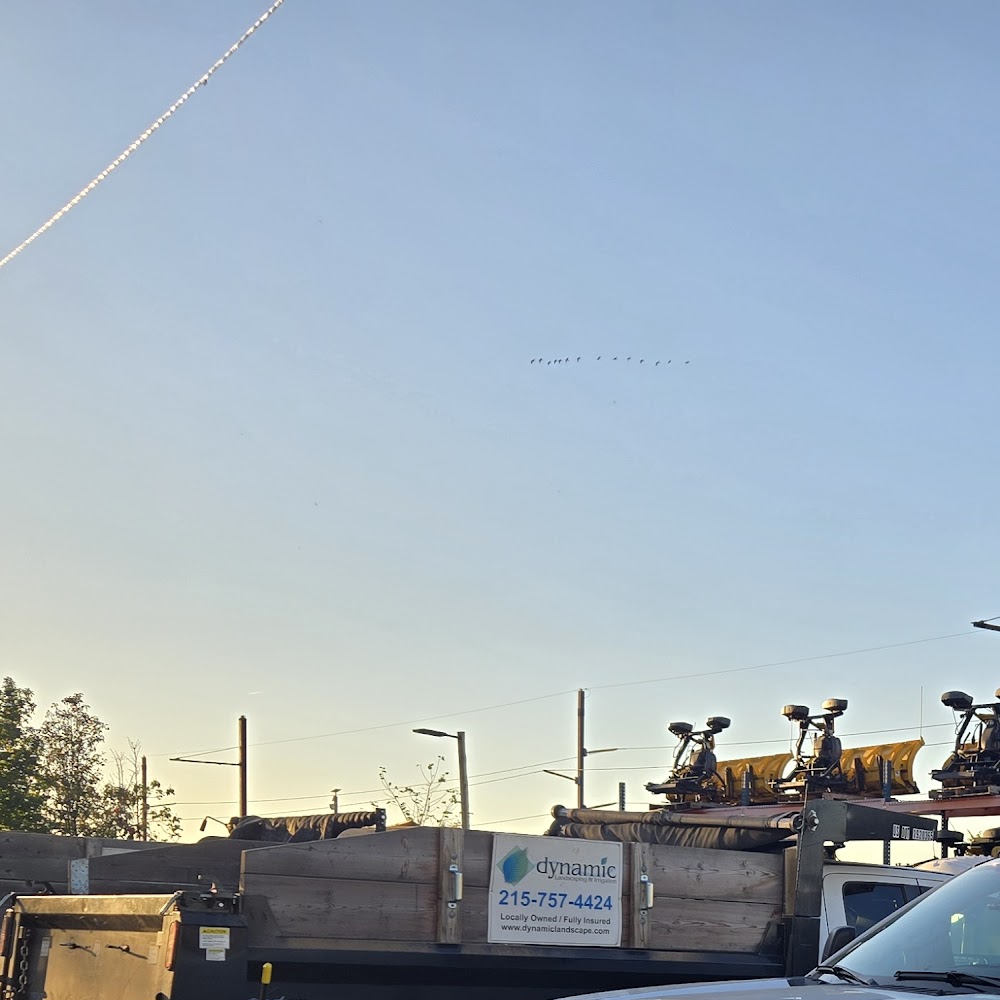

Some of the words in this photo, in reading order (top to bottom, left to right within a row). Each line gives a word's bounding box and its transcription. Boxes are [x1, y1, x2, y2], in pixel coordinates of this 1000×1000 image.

[536, 857, 617, 879] dynamic
[554, 874, 587, 883] Landscaping
[498, 889, 613, 911] 215-757-4424
[500, 913, 528, 923] Locally
[530, 914, 557, 923] Owned
[563, 916, 581, 925] Fully
[583, 917, 611, 925] Insured
[501, 924, 610, 935] www.dynamiclandscape.com
